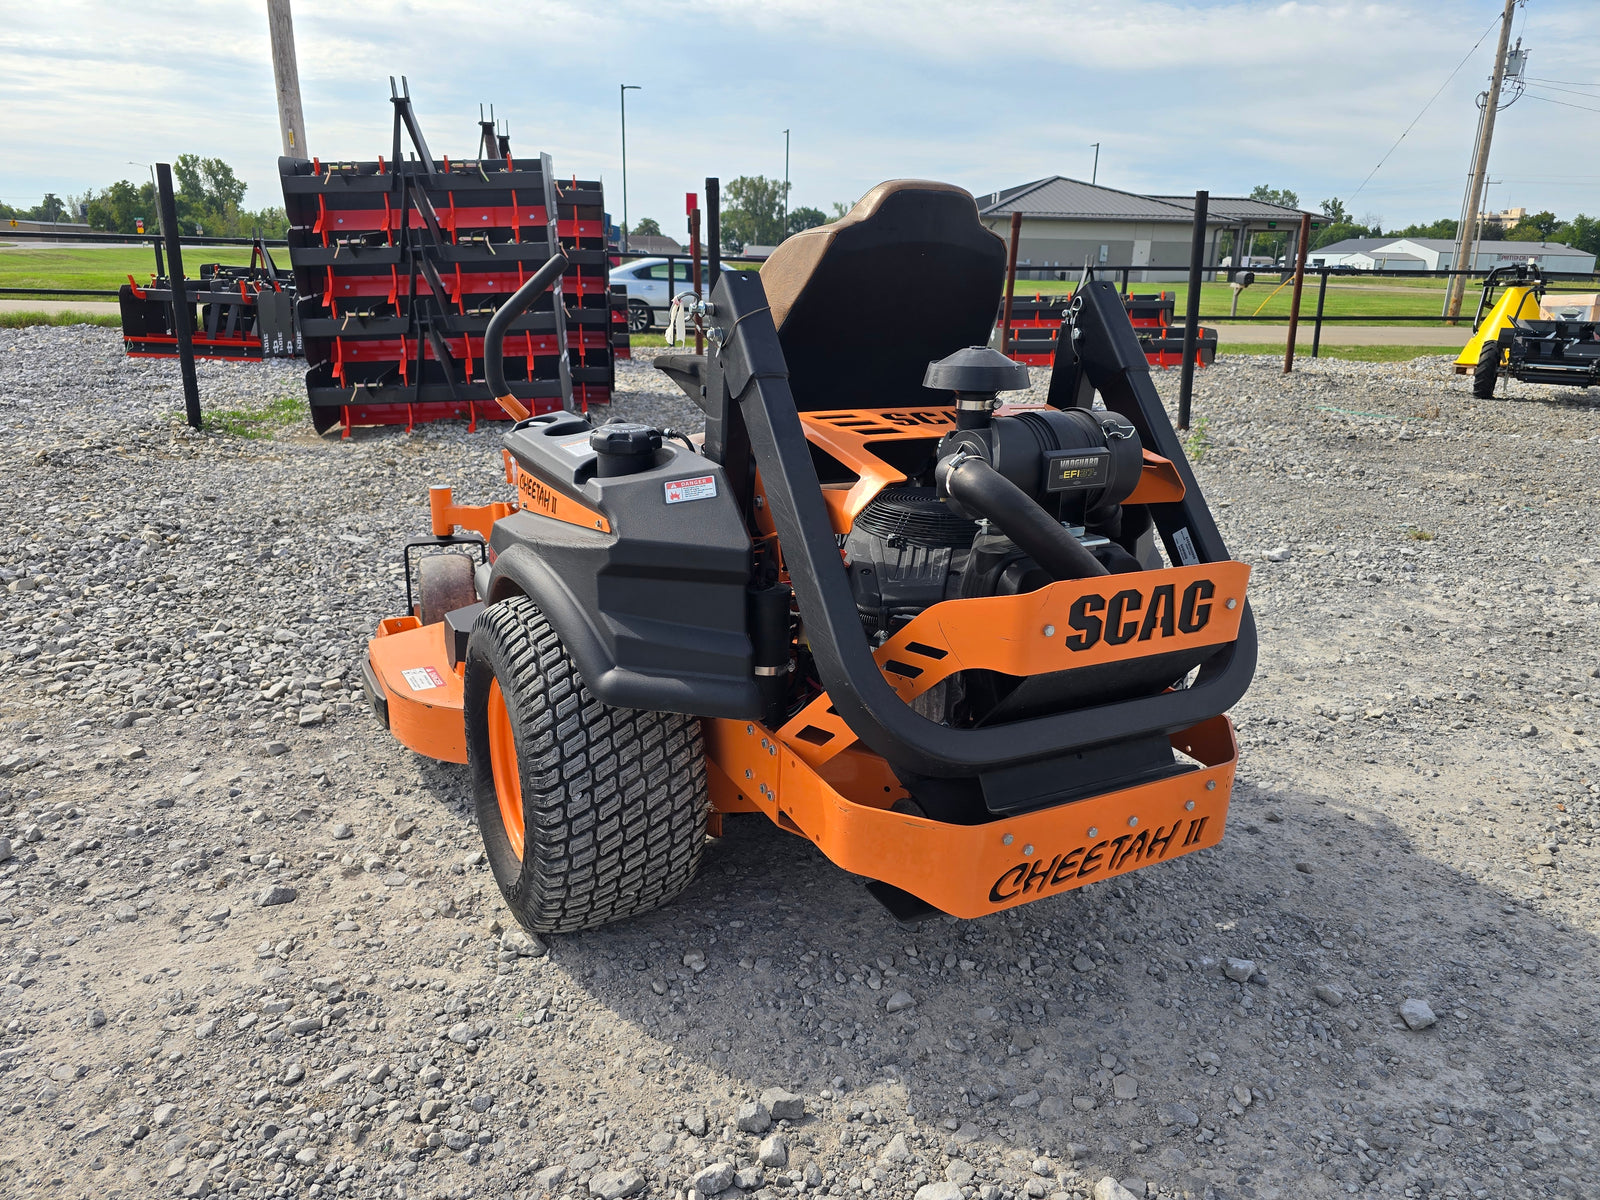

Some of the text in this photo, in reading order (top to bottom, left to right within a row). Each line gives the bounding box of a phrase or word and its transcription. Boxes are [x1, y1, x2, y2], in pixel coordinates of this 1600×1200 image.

[680, 479, 707, 487] DANGER
[1060, 458, 1099, 468] VANGUARD
[520, 473, 558, 515] CHEETAH II
[1065, 579, 1215, 652] SCAG
[988, 816, 1210, 904] CHEETAH II
